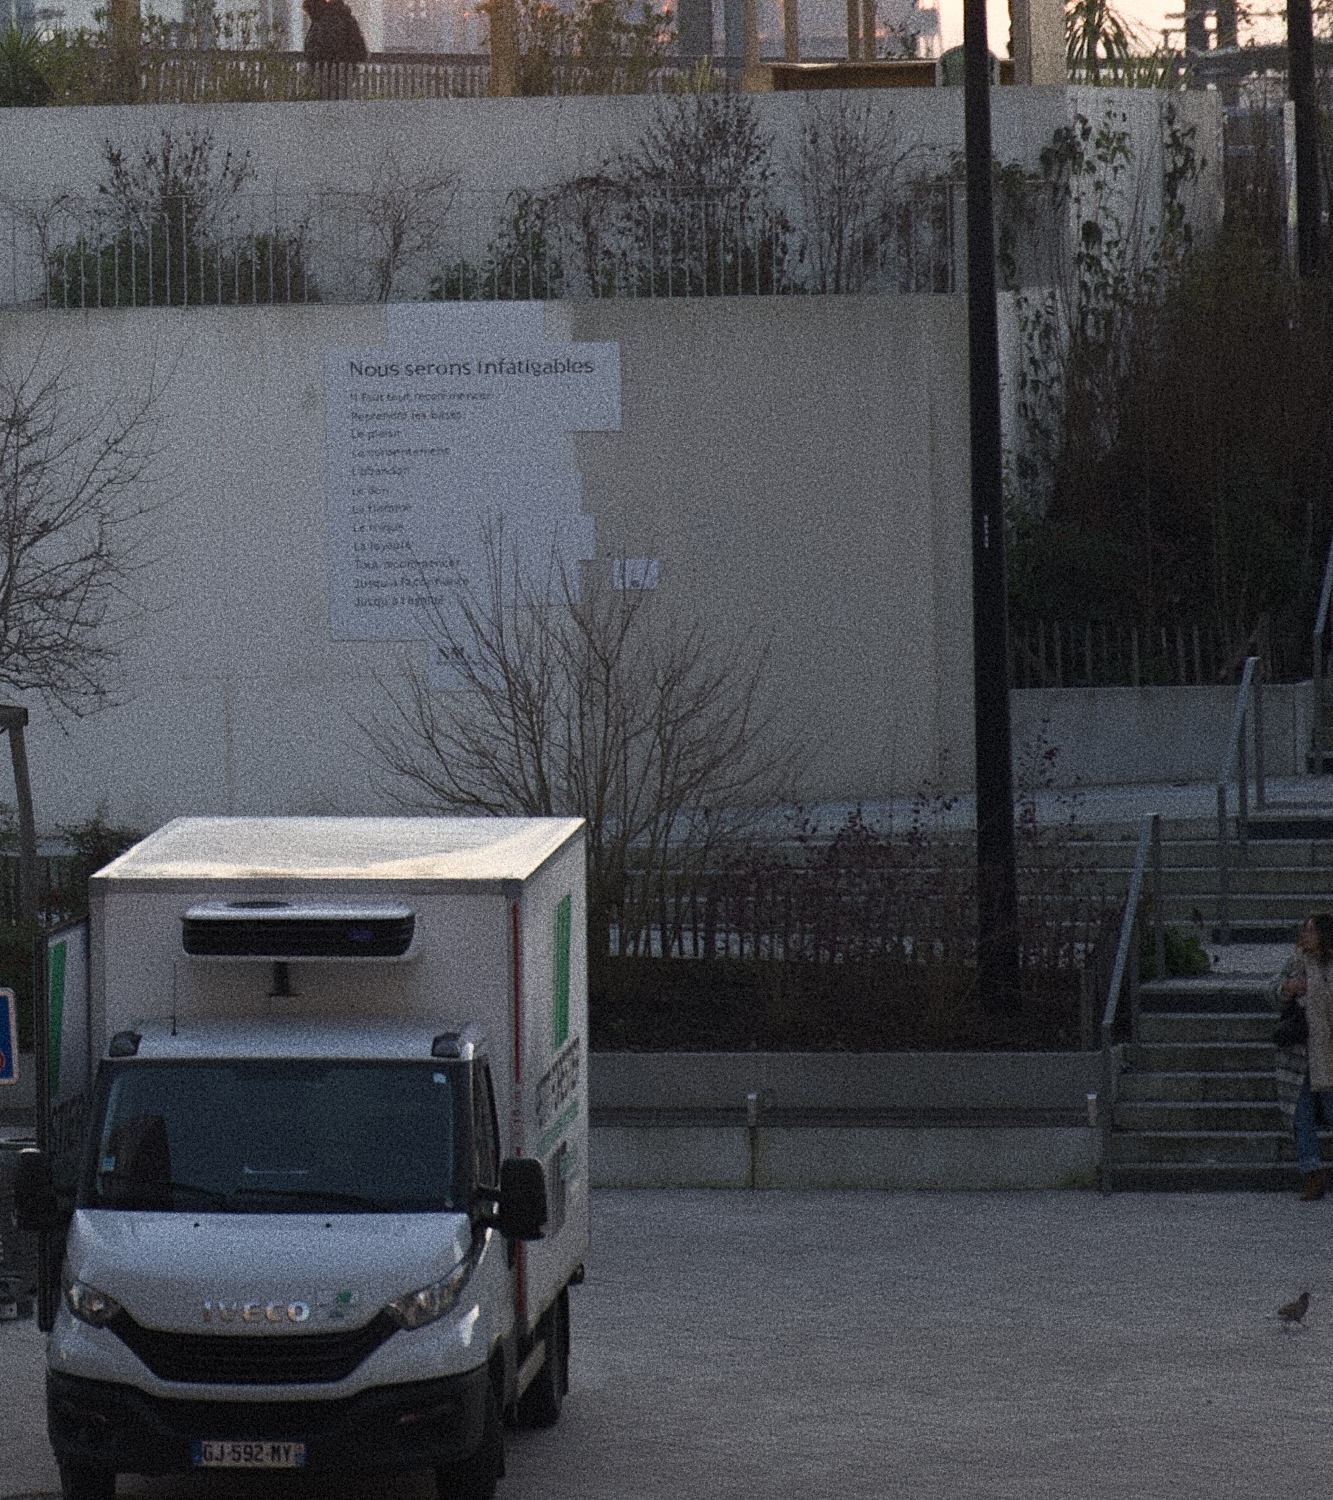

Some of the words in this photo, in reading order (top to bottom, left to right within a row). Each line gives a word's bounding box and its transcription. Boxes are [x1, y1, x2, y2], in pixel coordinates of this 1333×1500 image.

[350, 361, 399, 378] Nous
[405, 359, 470, 377] serons
[202, 1298, 311, 1323] IVECO
